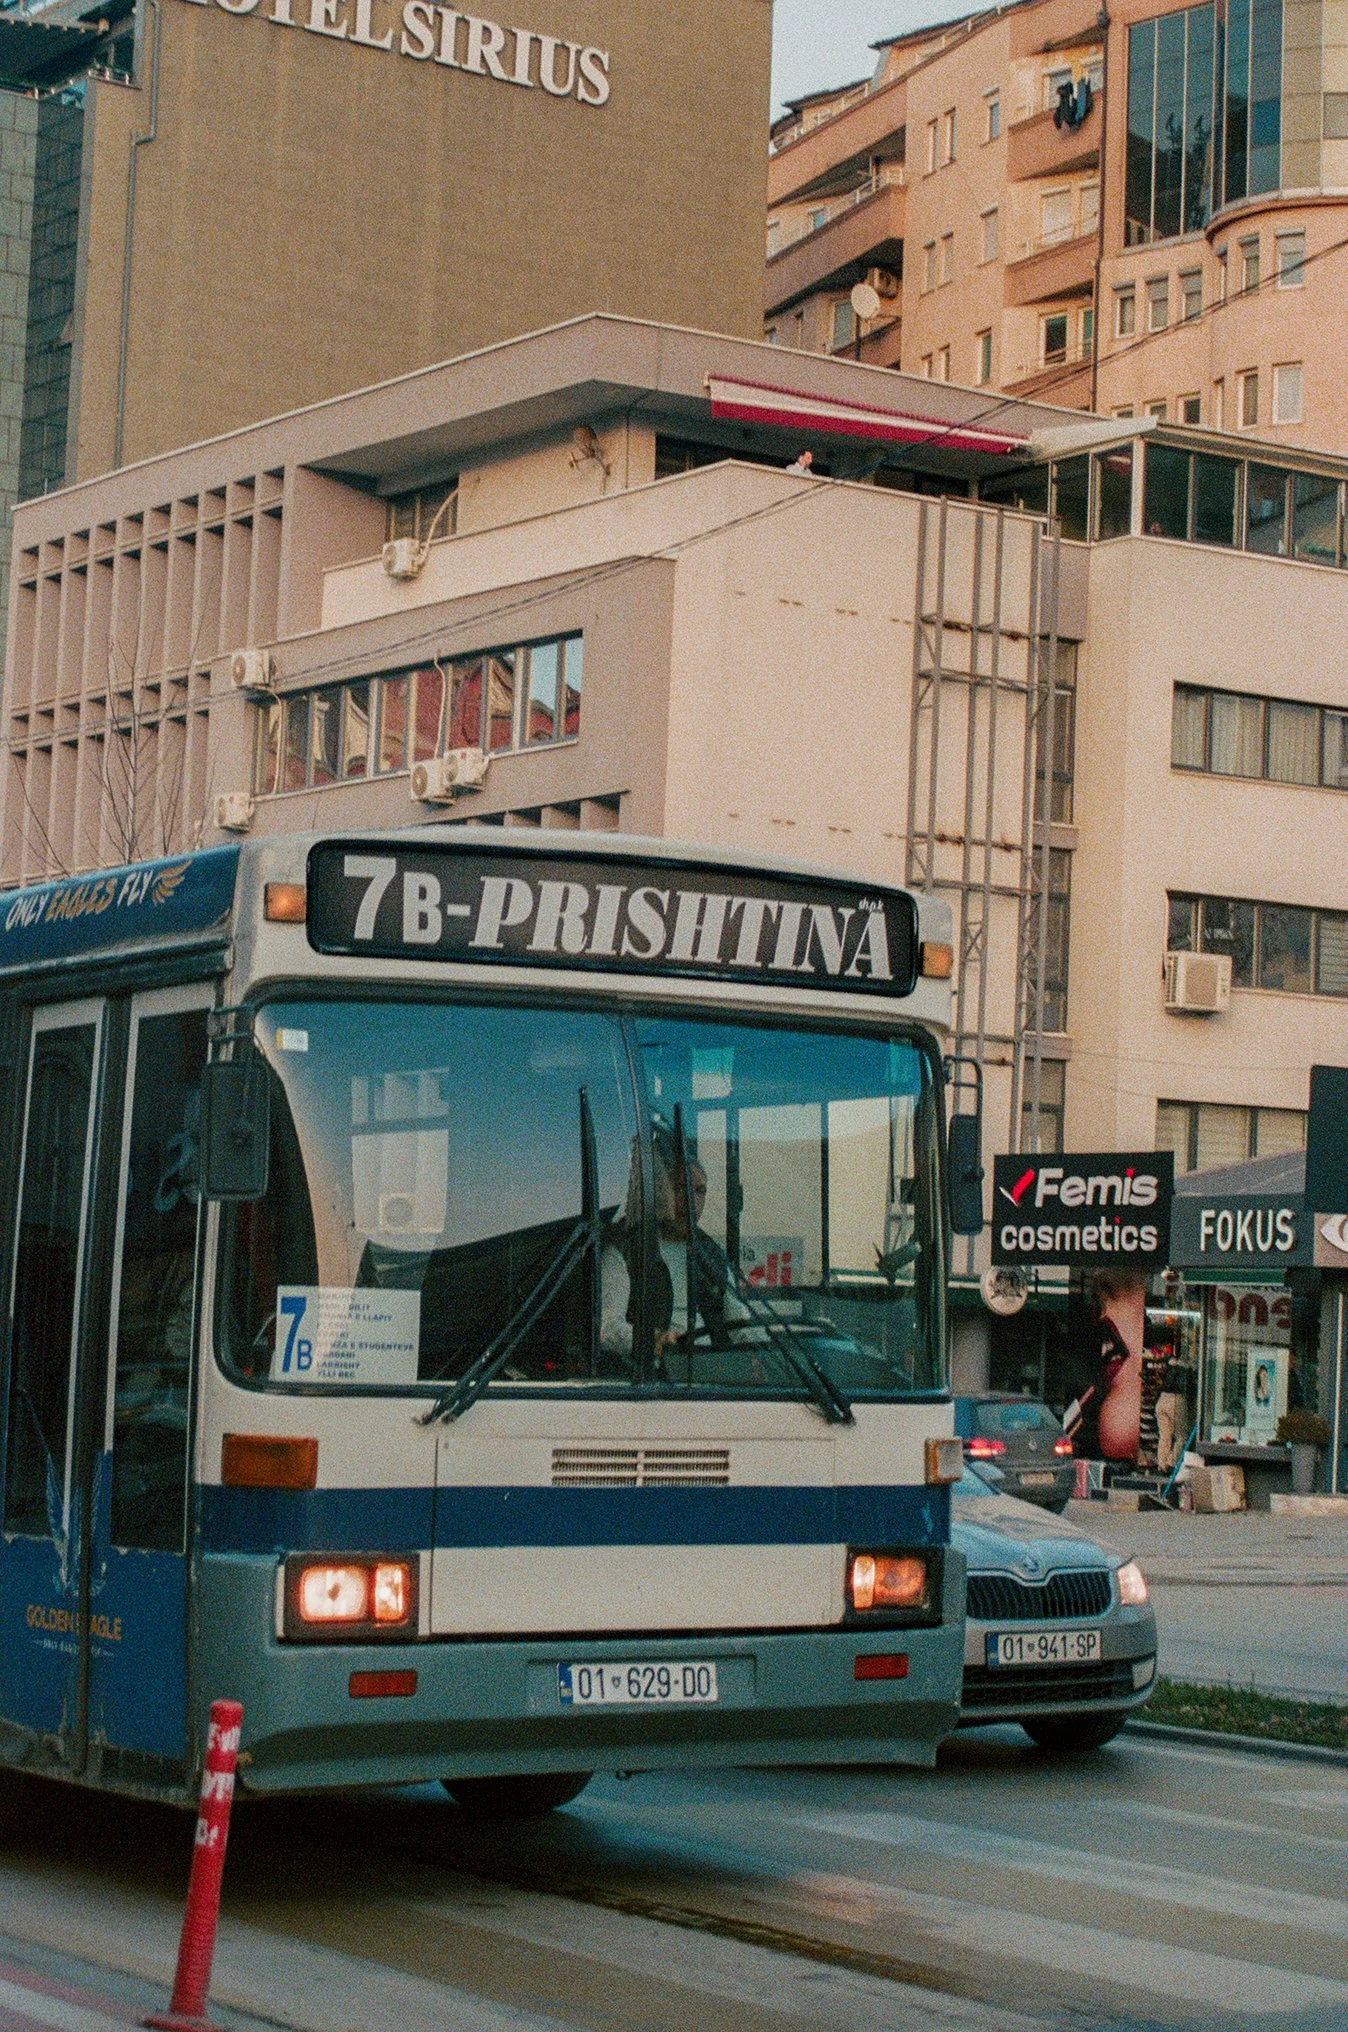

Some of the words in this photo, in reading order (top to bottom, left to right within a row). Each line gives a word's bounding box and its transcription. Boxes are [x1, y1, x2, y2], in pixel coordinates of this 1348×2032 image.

[401, 0, 610, 106] SIRIUS
[5, 894, 49, 932] ONLY
[45, 877, 118, 924] EAGLES
[117, 870, 153, 907] FLY
[1034, 1167, 1158, 1208] Femis
[1000, 1216, 1158, 1251] cosmetics
[1200, 1208, 1295, 1251] FOKUS
[26, 1604, 75, 1633] GOLDEN
